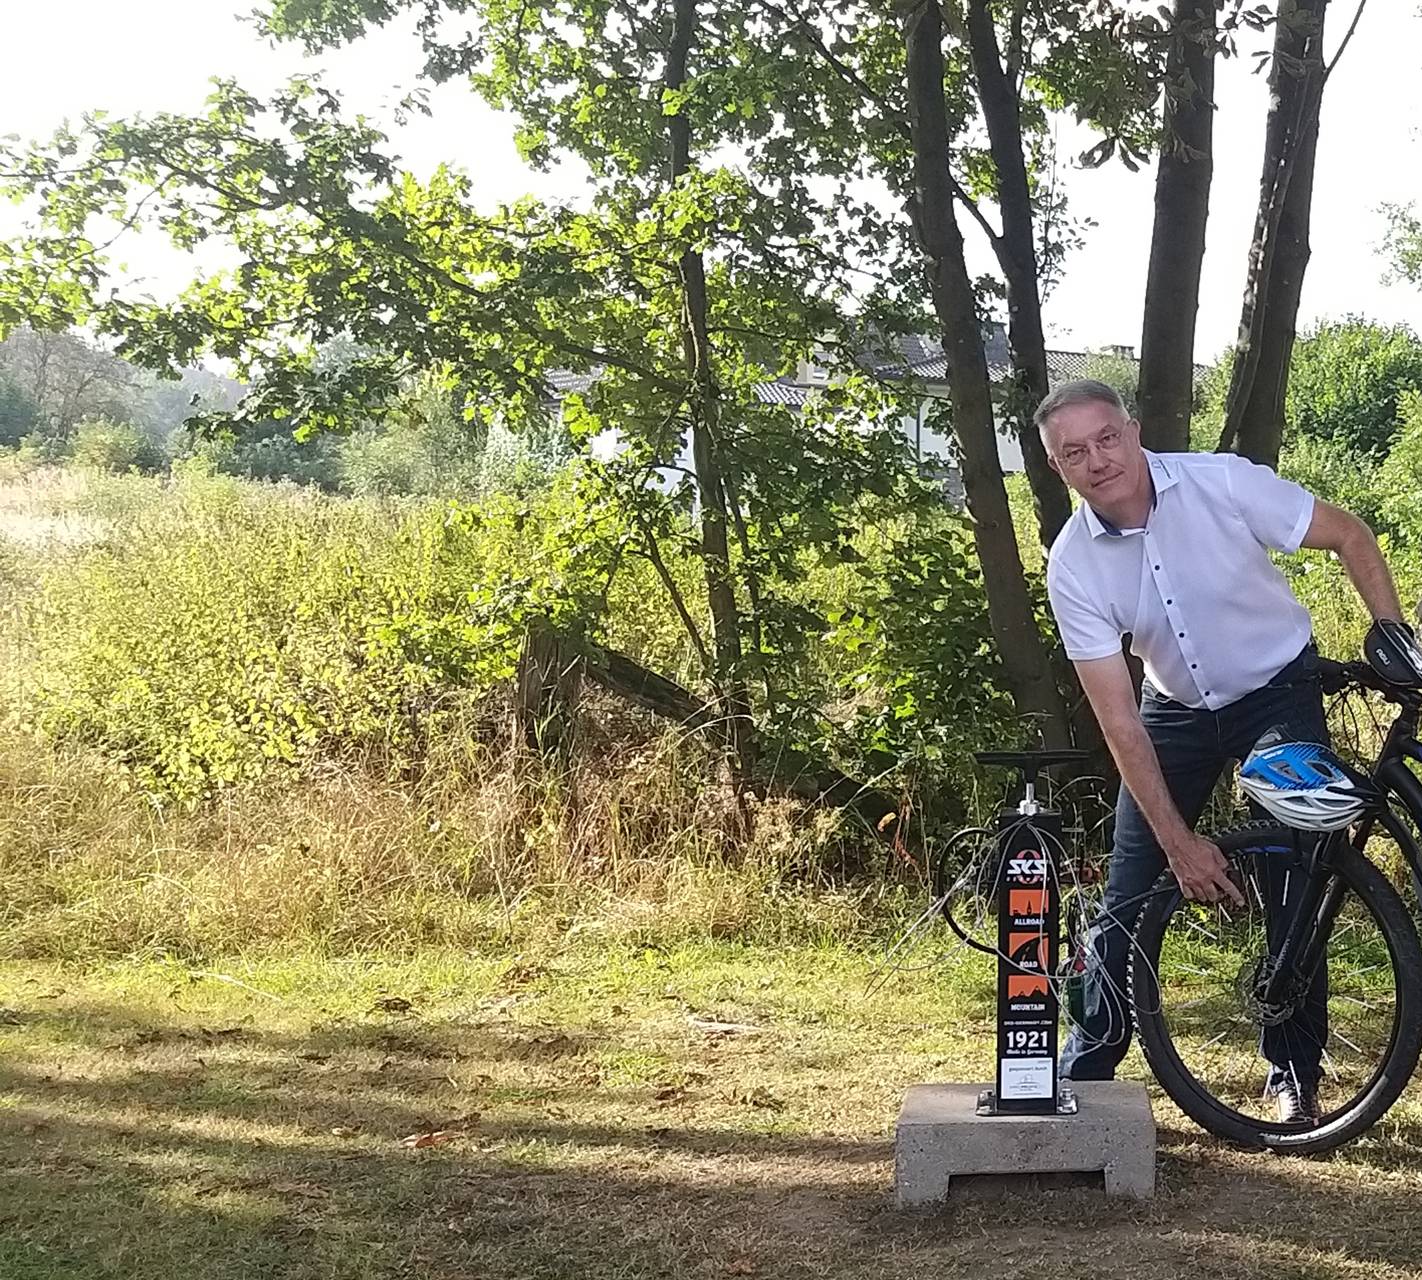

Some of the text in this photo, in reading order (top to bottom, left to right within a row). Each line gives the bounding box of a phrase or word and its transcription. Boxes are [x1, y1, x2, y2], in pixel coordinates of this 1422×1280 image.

[1006, 859, 1047, 875] SKS
[1019, 960, 1039, 969] ROAD
[1010, 1003, 1046, 1011] MOUNTAIN
[1006, 1030, 1049, 1049] 1921
